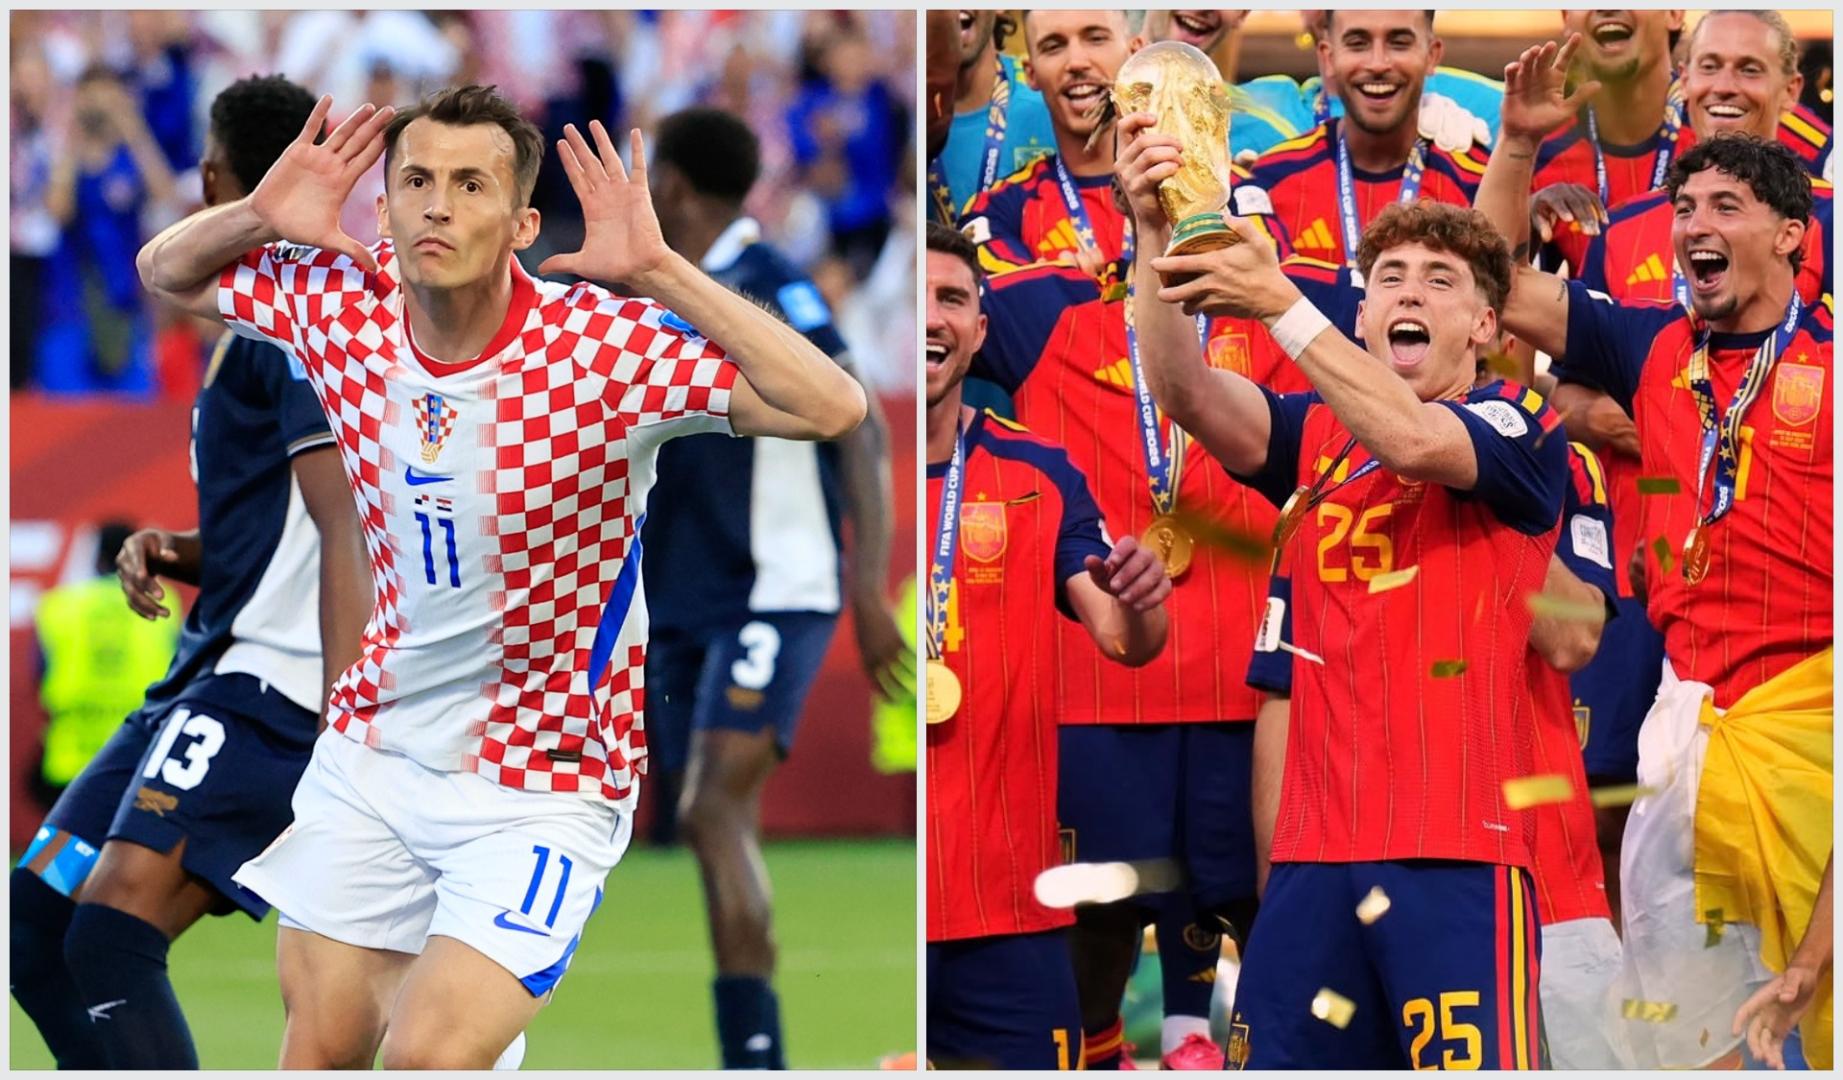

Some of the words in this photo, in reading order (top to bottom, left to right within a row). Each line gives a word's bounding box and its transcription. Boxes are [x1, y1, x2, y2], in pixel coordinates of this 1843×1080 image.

[1343, 195, 1354, 215] CUP
[1142, 404, 1155, 428] CUP
[1146, 428, 1161, 467] 2026
[948, 466, 960, 490] CUP
[943, 490, 958, 532] WORLD
[414, 511, 461, 588] 11
[940, 530, 952, 557] FIFA
[1317, 502, 1393, 582] 25
[731, 621, 782, 690] 3
[142, 708, 226, 791] 13
[520, 845, 573, 929] 11
[1403, 990, 1482, 1071] 25
